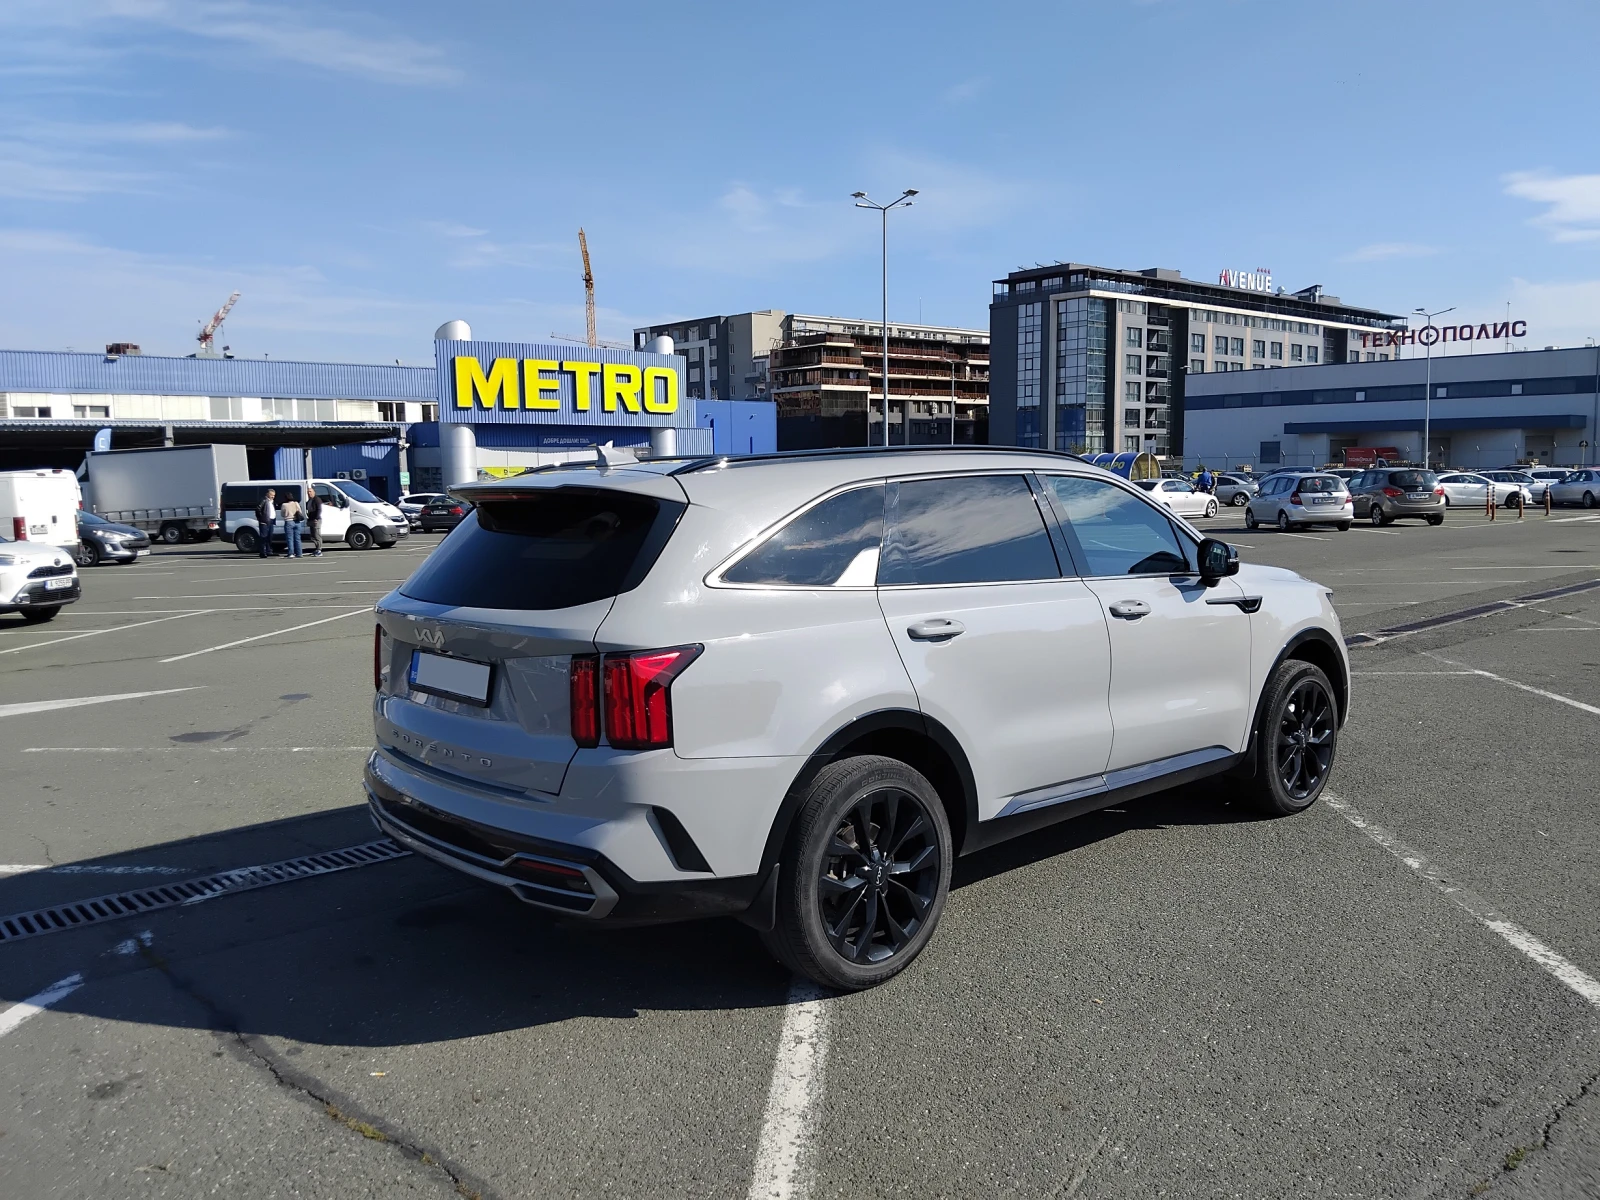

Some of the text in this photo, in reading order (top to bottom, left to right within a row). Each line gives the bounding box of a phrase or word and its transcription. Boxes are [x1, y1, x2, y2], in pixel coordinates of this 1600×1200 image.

[1220, 268, 1272, 293] AVENUE
[1359, 320, 1527, 348] ТЕХНОПОЛИС
[454, 355, 679, 414] METRO
[392, 729, 492, 767] SORENTO
